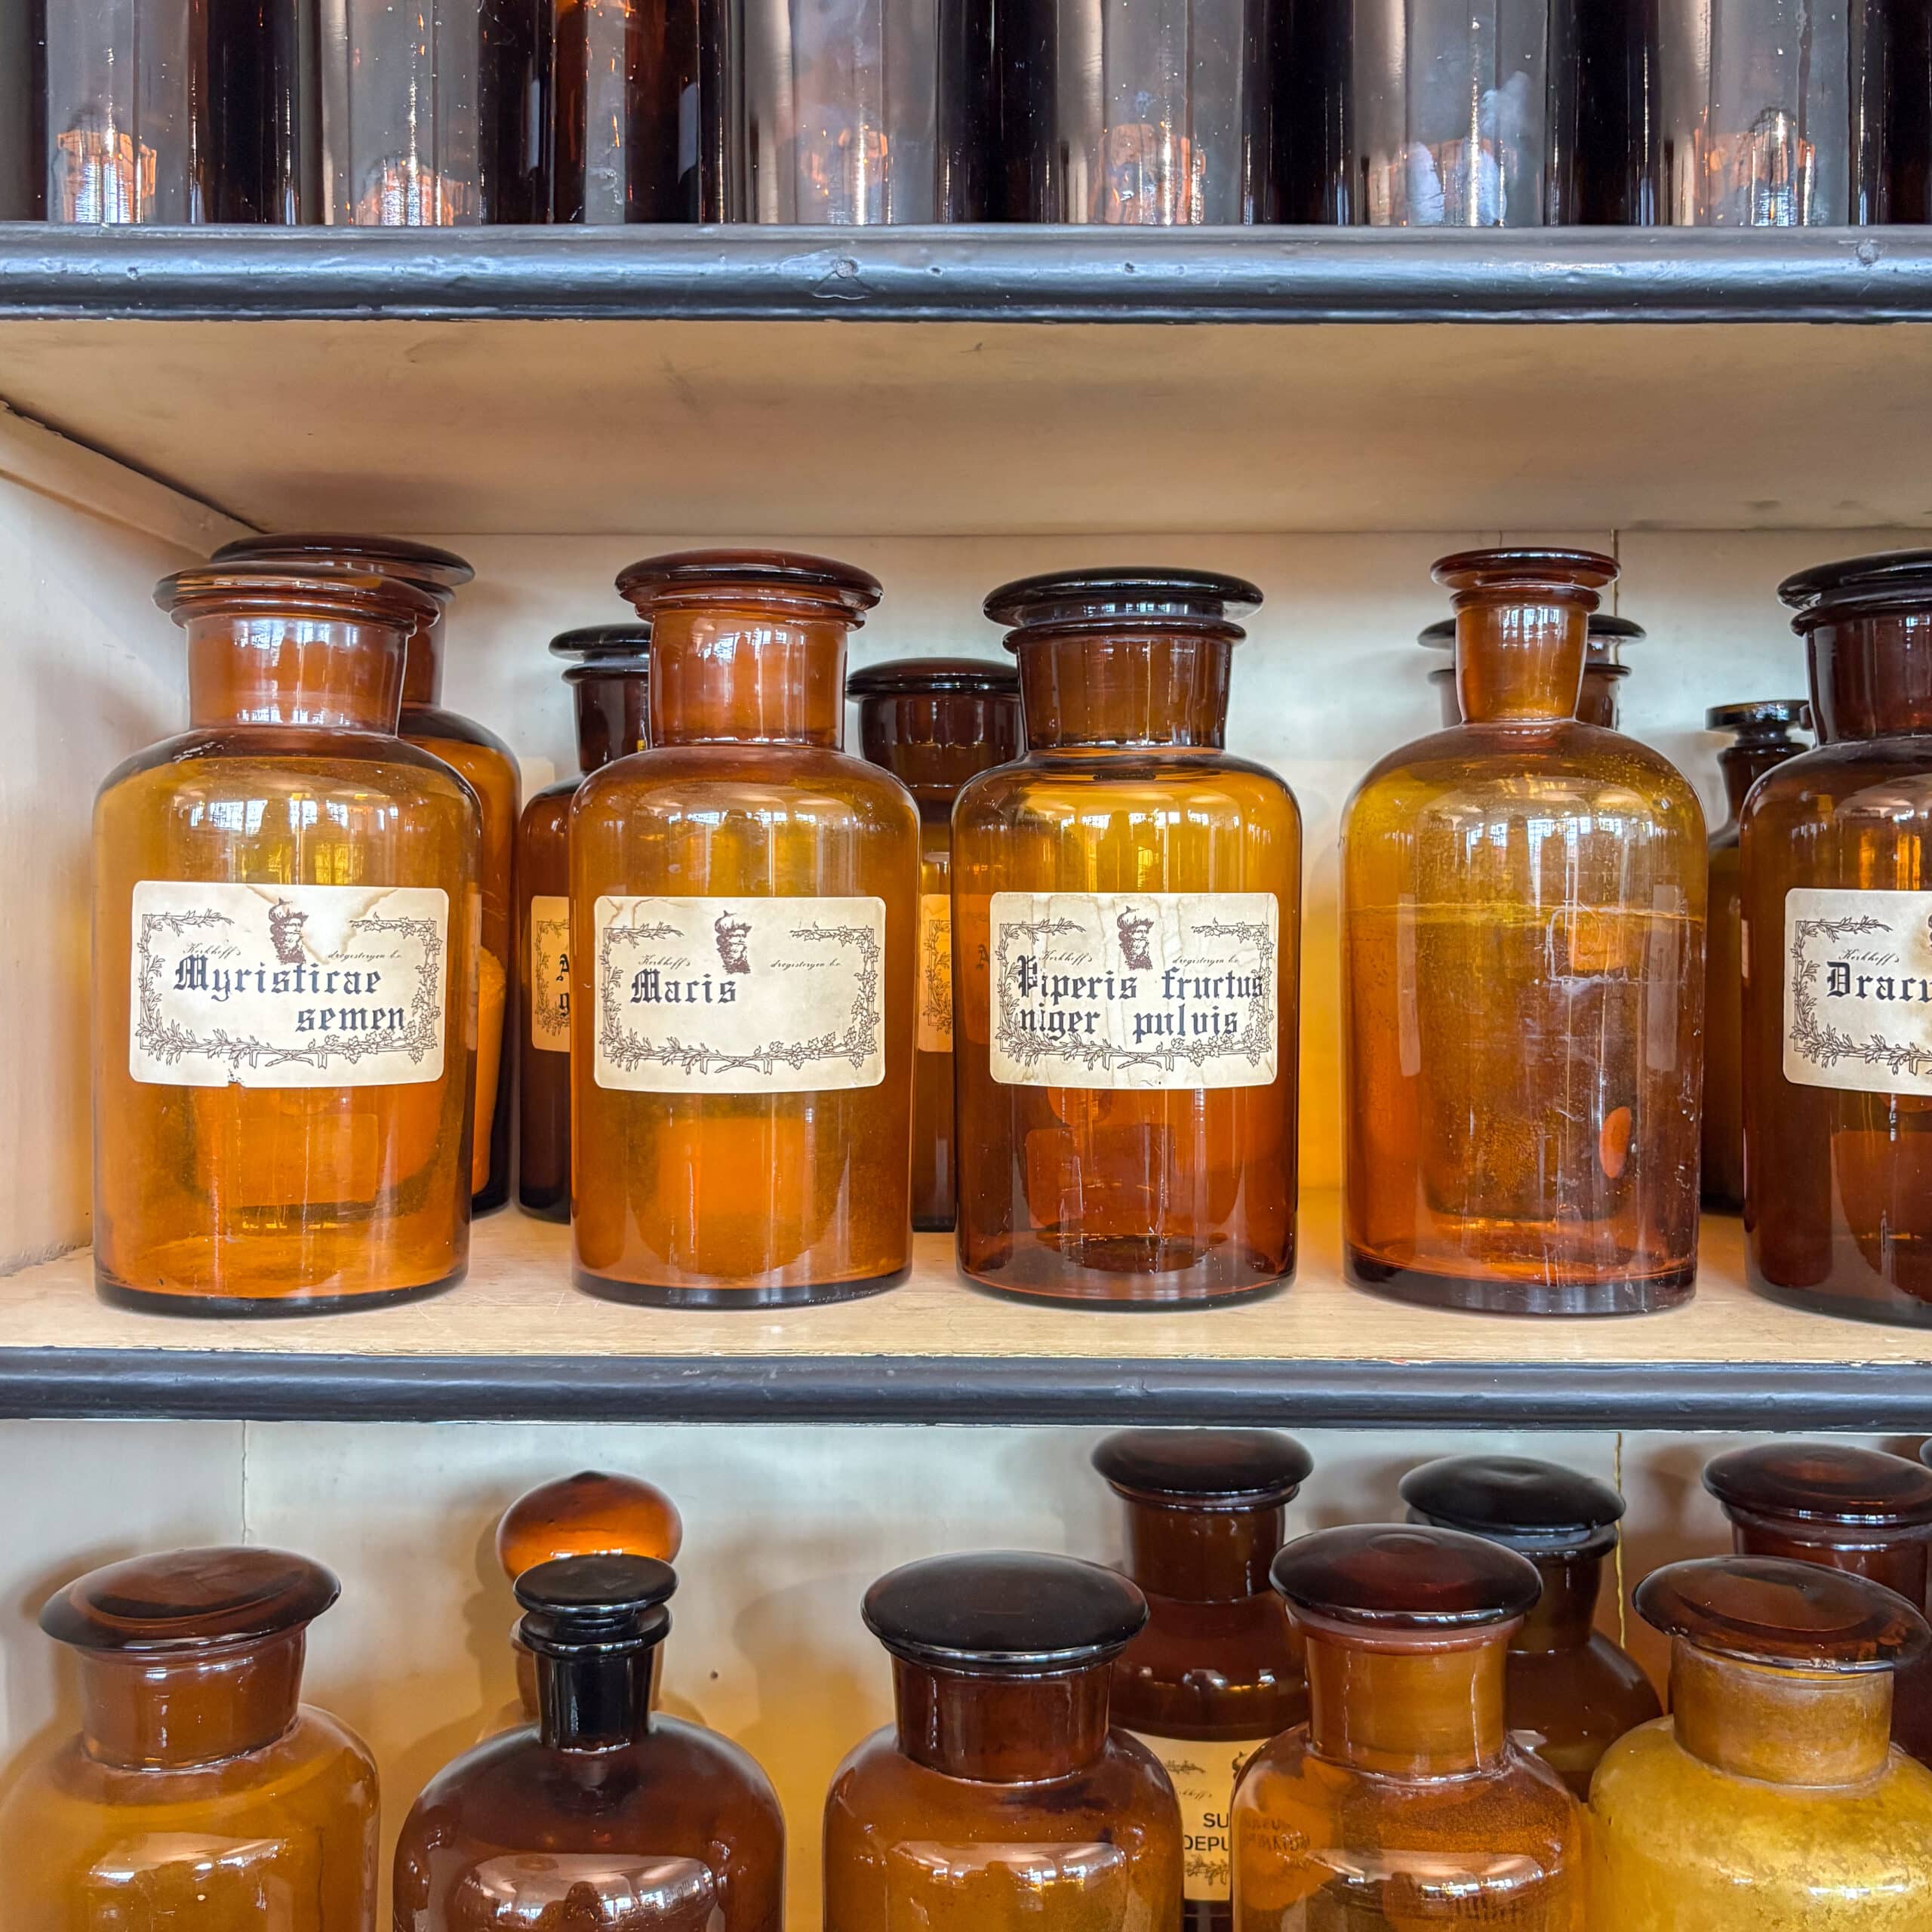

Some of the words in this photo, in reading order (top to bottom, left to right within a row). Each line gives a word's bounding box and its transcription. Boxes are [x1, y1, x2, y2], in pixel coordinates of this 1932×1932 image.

[174, 954, 382, 1002] Myristicae
[1017, 955, 1137, 1005] Piperis
[1161, 966, 1263, 1001] fructus
[295, 1006, 405, 1033] semen
[1019, 1002, 1101, 1041] niger
[1134, 1004, 1238, 1044] pulvis
